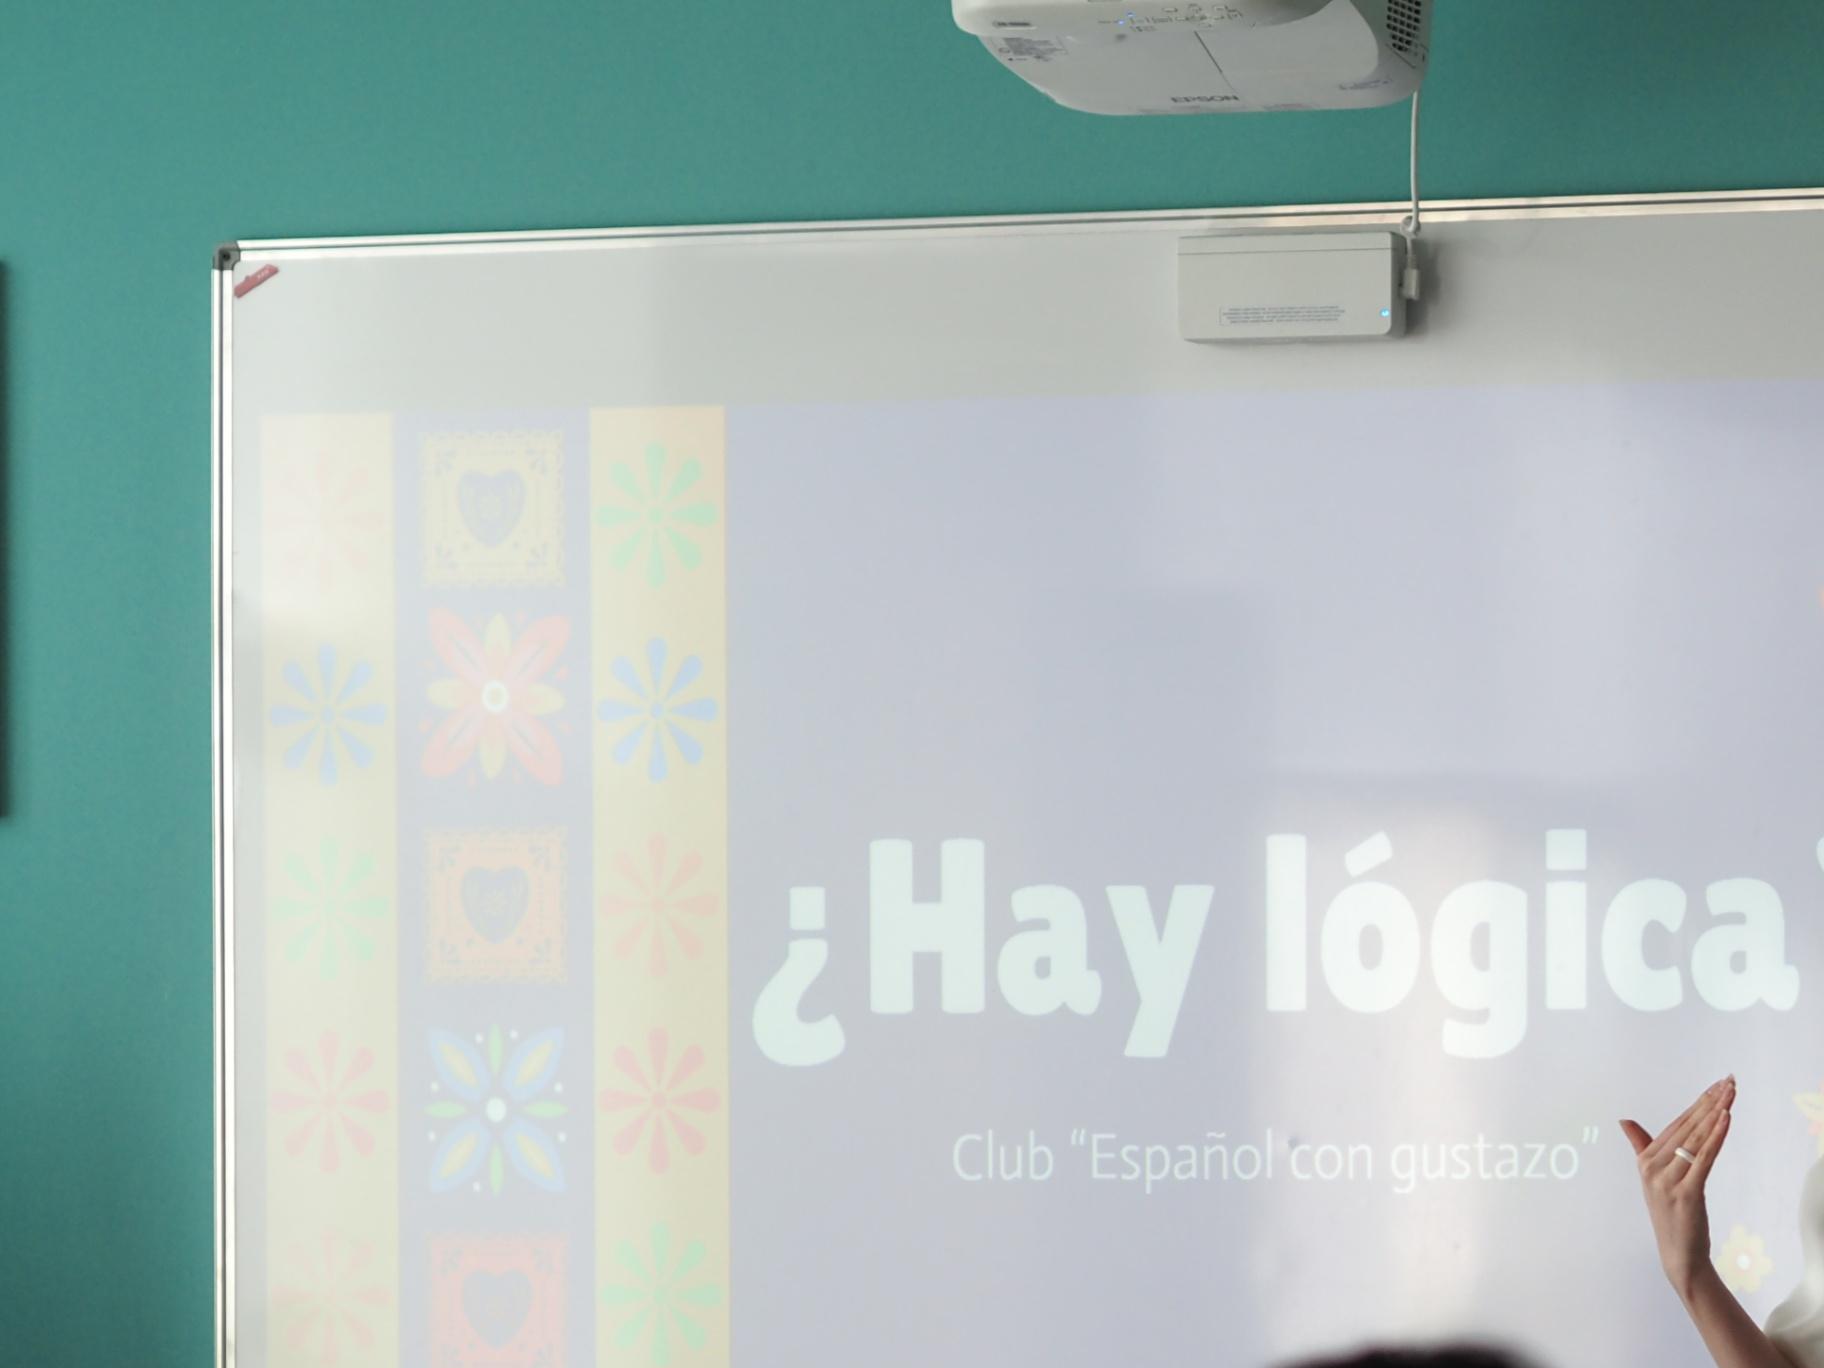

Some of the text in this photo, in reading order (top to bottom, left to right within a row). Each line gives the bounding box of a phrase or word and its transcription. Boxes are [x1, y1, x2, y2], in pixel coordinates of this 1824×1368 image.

[1170, 94, 1240, 103] EPSON
[752, 838, 1215, 1066] ¿Hay
[953, 1129, 1054, 1181] Club
[1290, 1142, 1373, 1181] con
